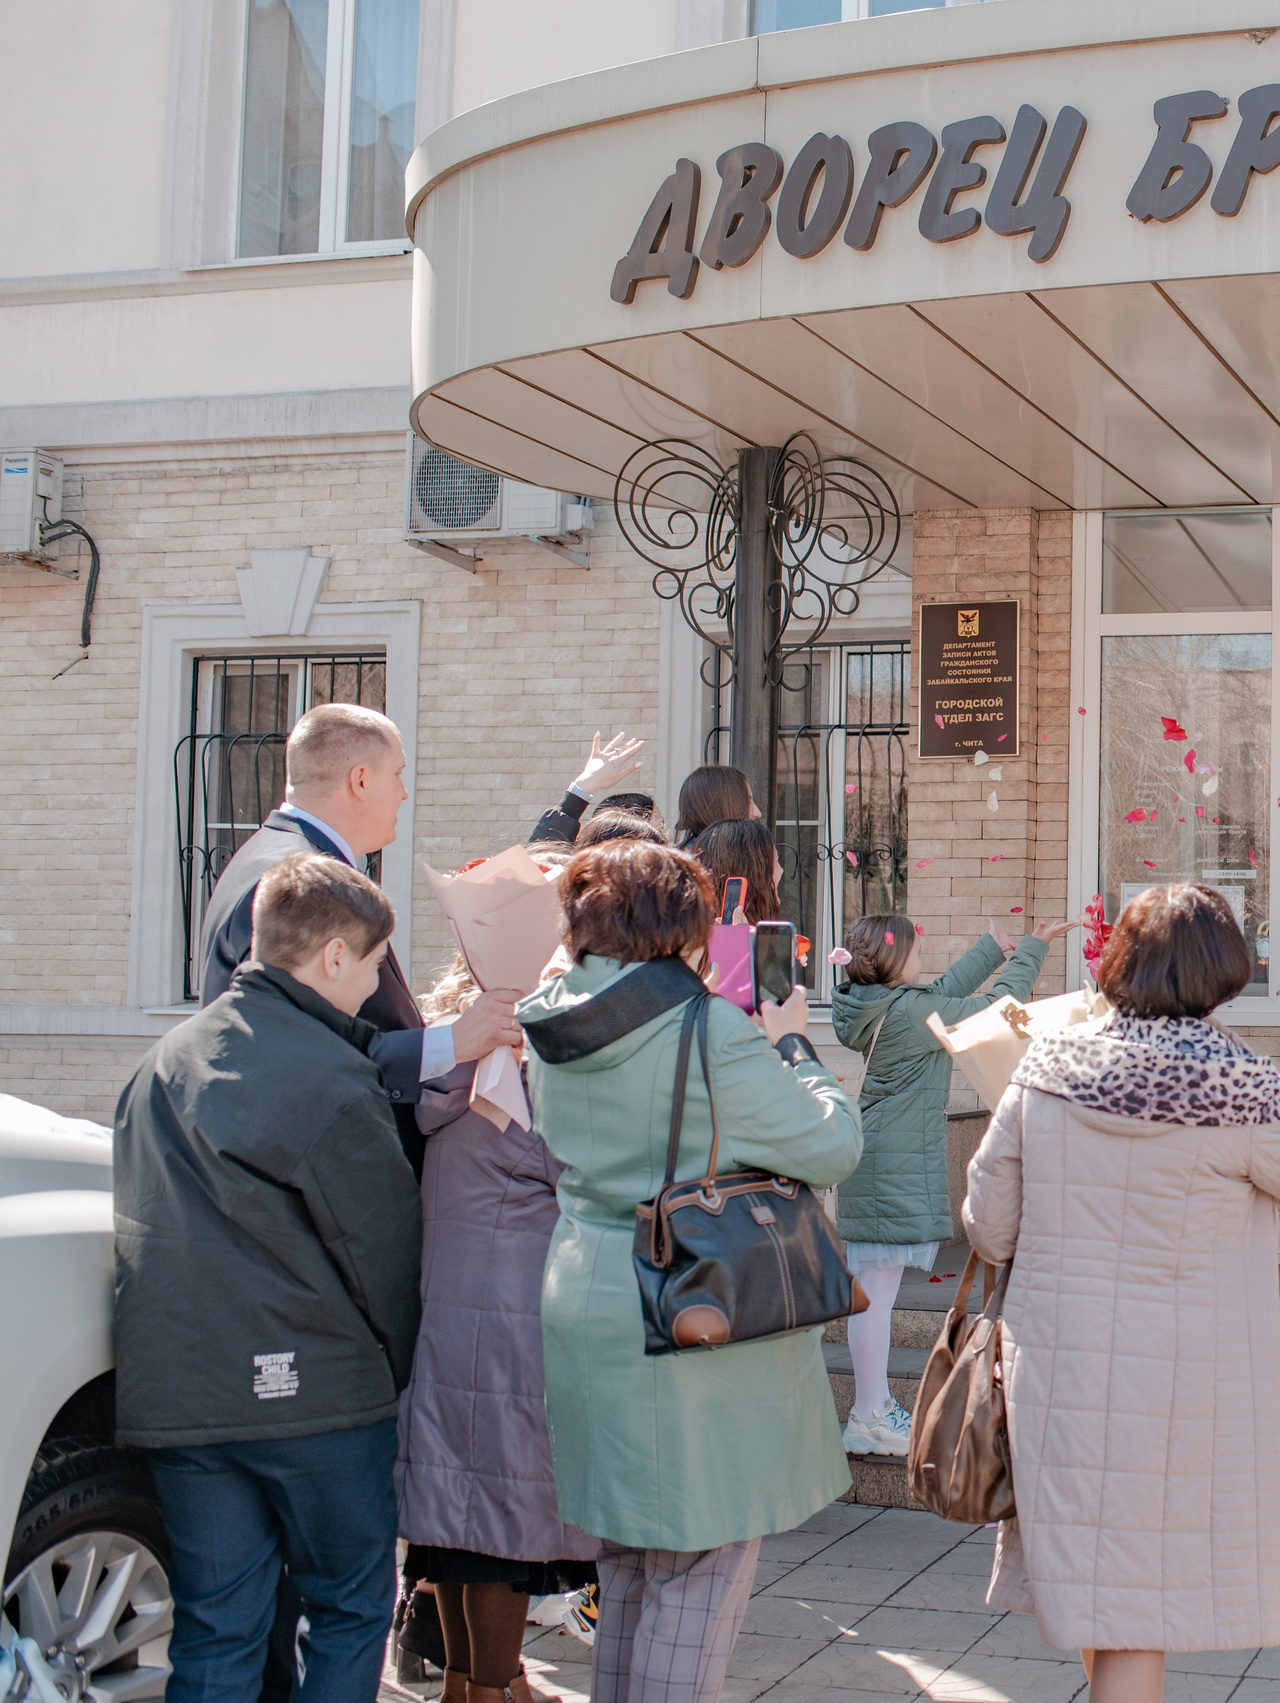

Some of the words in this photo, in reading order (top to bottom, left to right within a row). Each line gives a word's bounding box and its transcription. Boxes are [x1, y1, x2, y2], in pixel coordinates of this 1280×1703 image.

[610, 103, 1088, 305] ДВОРЕЦ
[943, 641, 996, 650] ДЕПАРТАМЕНТ
[940, 659, 998, 667] ГРАЖДАНСКОГО
[947, 668, 991, 676] СОСТОЯНИЯ
[926, 677, 992, 685] ЗАБАЙКАЛЬСКОГО
[935, 696, 1003, 710] ГОРОДСКОЙ
[975, 712, 1004, 722] ЗАГС
[262, 1363, 290, 1375] CHILD
